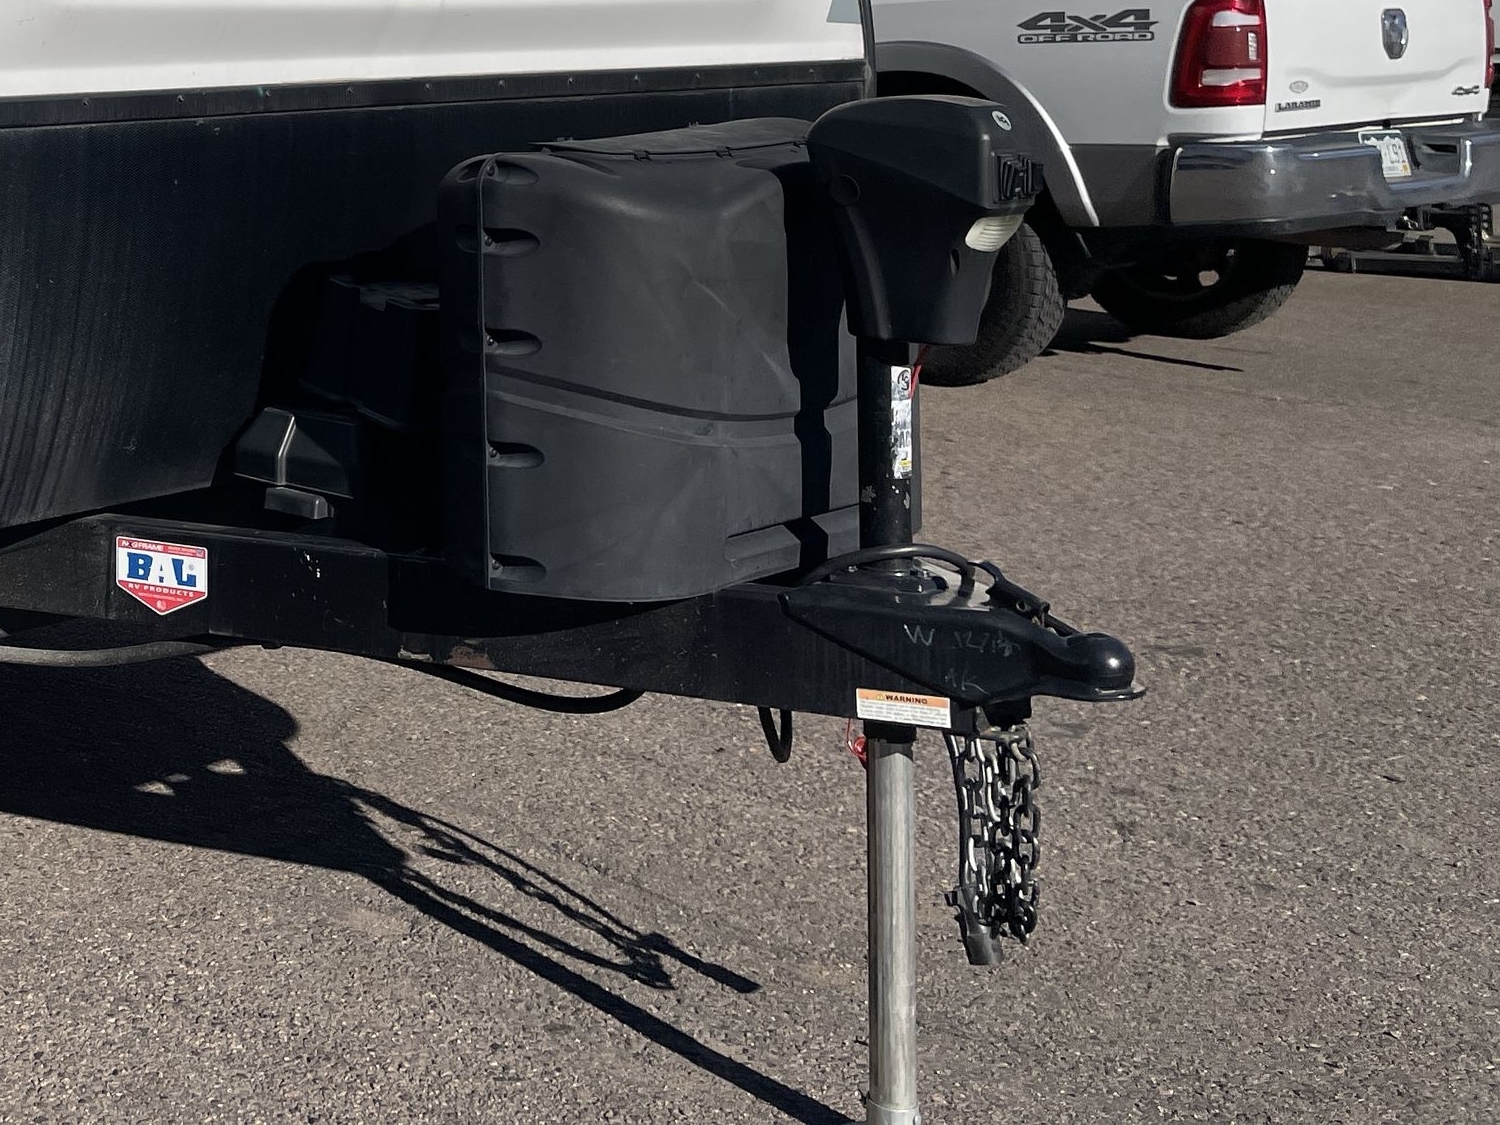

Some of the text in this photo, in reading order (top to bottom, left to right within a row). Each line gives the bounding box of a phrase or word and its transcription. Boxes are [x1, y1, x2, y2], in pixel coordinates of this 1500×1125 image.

[1020, 32, 1151, 43] OFF ROAD
[144, 584, 194, 598] PRODUCTS
[885, 693, 928, 705] WARNING
